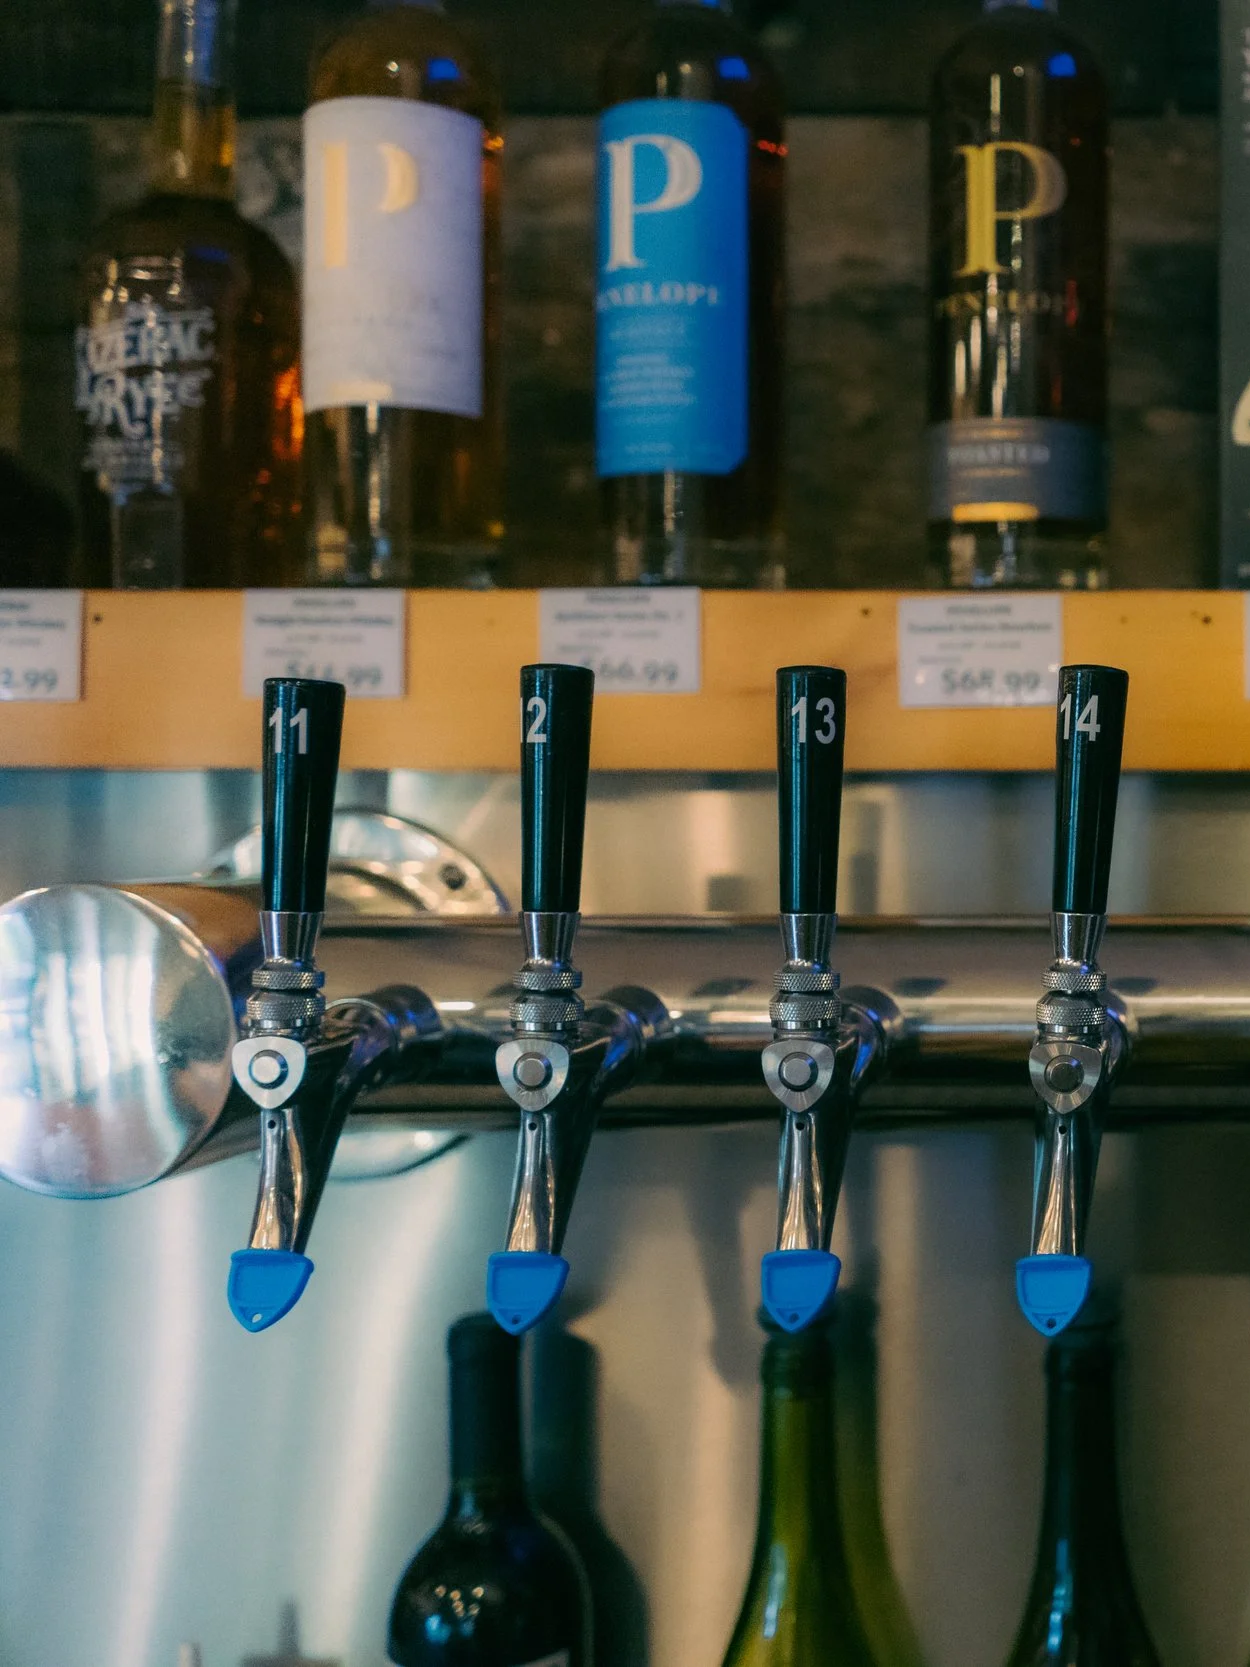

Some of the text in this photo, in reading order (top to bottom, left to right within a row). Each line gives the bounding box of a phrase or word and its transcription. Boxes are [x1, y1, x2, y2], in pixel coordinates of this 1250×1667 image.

[603, 134, 702, 272] P
[951, 140, 1068, 277] P
[269, 708, 308, 754] 11
[520, 697, 547, 743] 2
[791, 696, 836, 744] 13
[1060, 694, 1100, 741] 14
